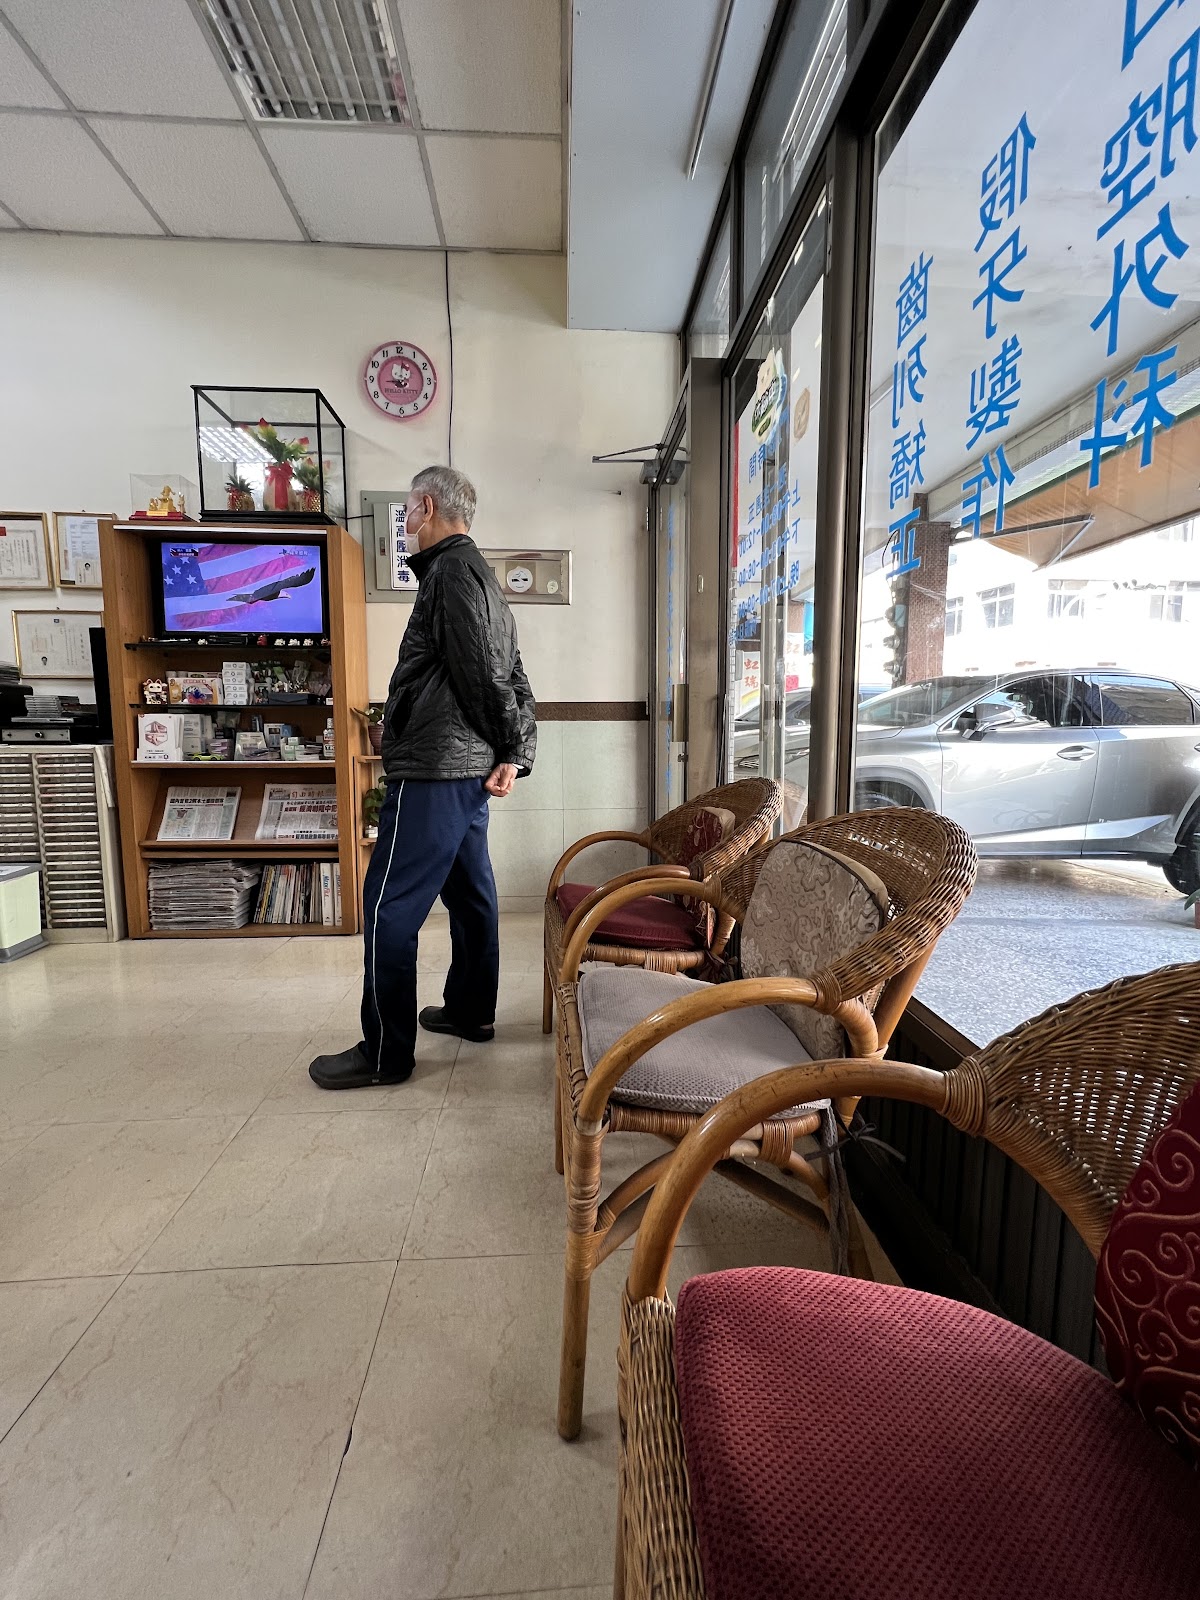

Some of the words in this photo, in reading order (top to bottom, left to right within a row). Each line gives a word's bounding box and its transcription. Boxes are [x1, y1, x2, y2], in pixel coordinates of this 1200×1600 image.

[396, 346, 403, 354] 12
[422, 362, 427, 370] 2
[369, 375, 374, 383] 9
[373, 391, 379, 399] 8
[423, 392, 428, 400] 4
